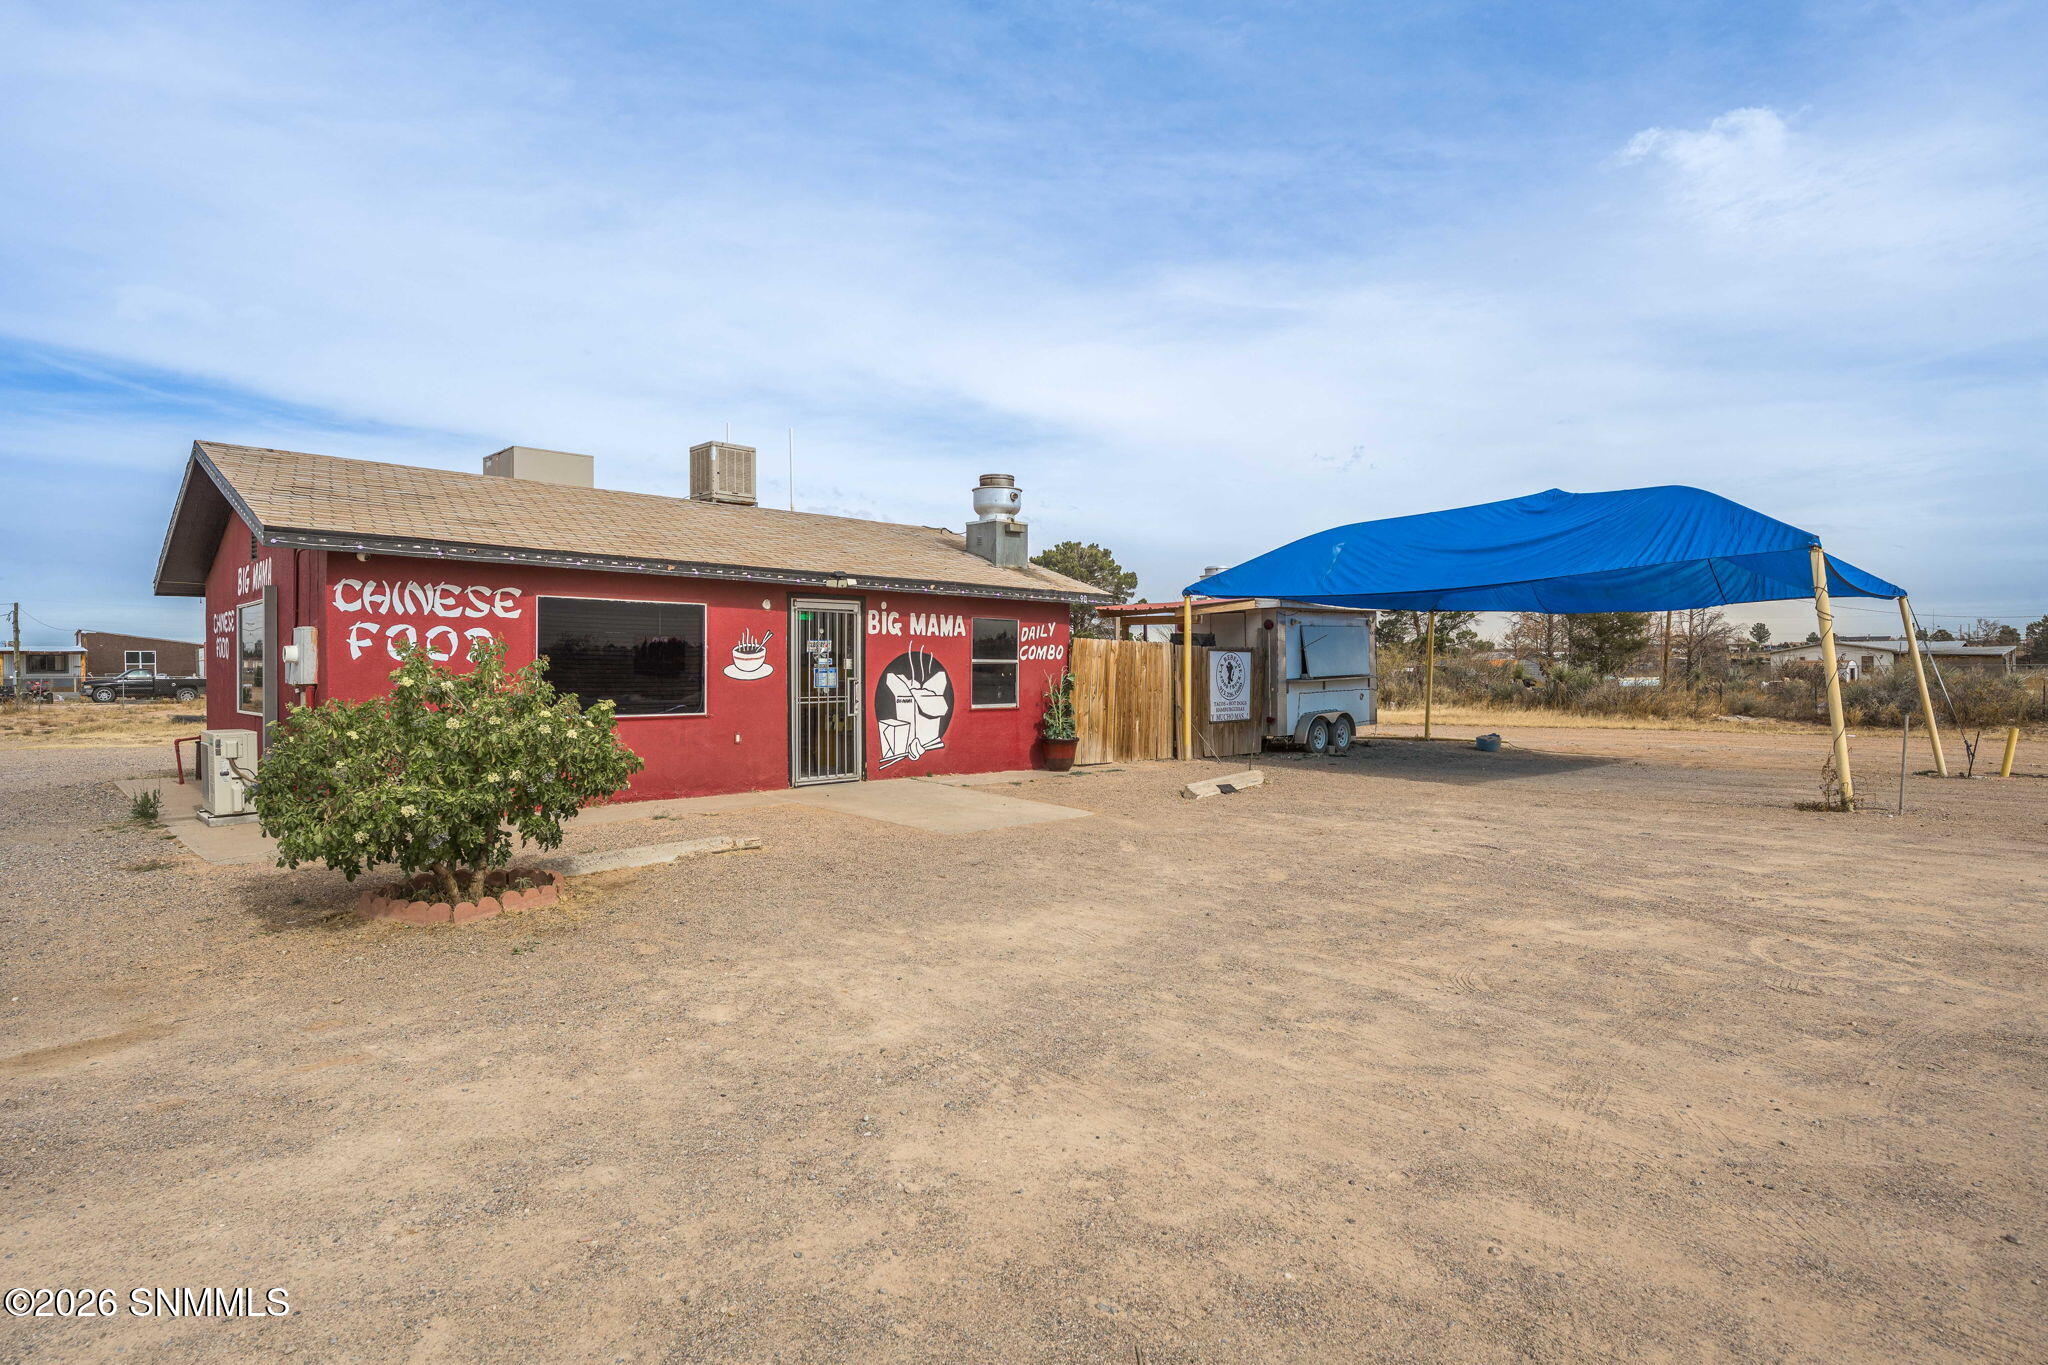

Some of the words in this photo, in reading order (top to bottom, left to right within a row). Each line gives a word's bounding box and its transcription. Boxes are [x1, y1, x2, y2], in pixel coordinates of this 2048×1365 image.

[237, 565, 250, 596] BIG
[333, 577, 522, 619] CHINESE
[213, 610, 235, 634] CHINESE
[910, 612, 967, 637] MAMA
[1021, 622, 1057, 642] DAILY
[216, 635, 230, 660] FOOD
[346, 621, 494, 663] FOOD
[1020, 645, 1065, 661] COMBO
